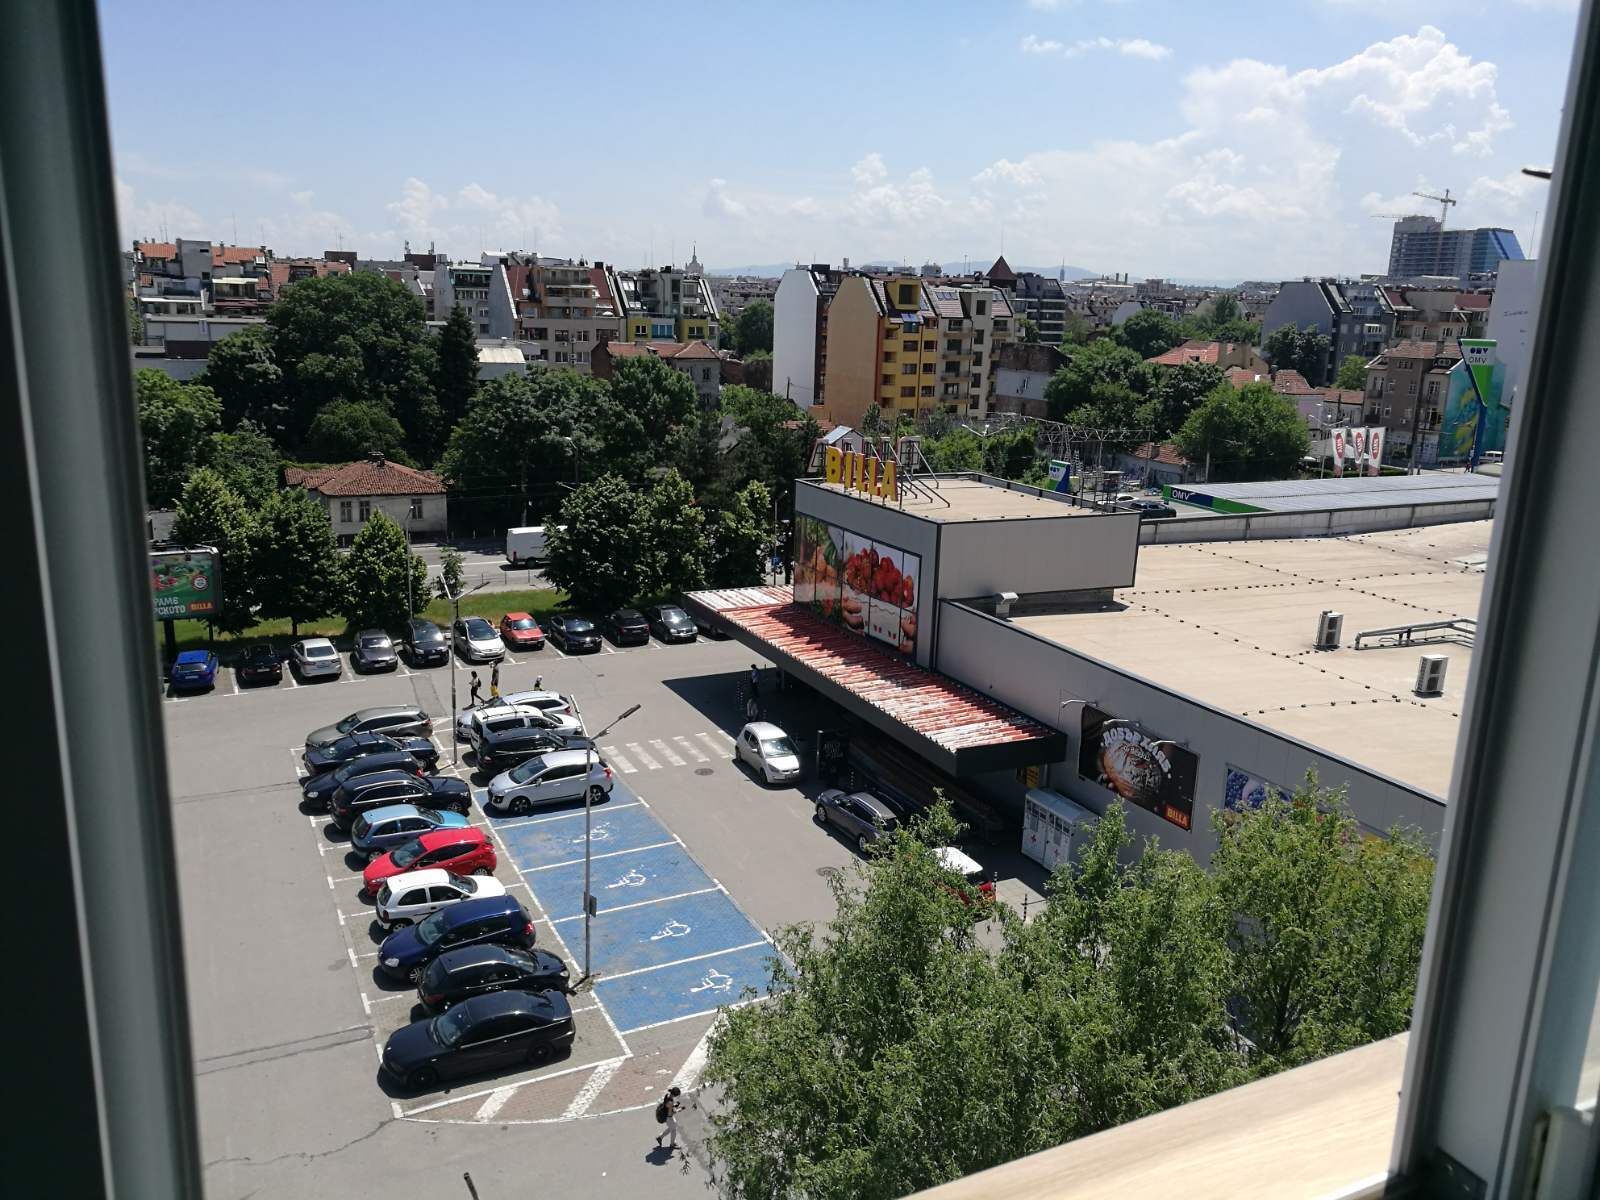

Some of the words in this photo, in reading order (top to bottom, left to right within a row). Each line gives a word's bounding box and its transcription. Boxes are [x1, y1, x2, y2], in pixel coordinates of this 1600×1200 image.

[1469, 356, 1488, 364] OMV
[825, 445, 899, 502] BILLA
[1172, 489, 1190, 501] OMV
[191, 602, 213, 611] BILLA
[1167, 807, 1189, 827] BILLA
